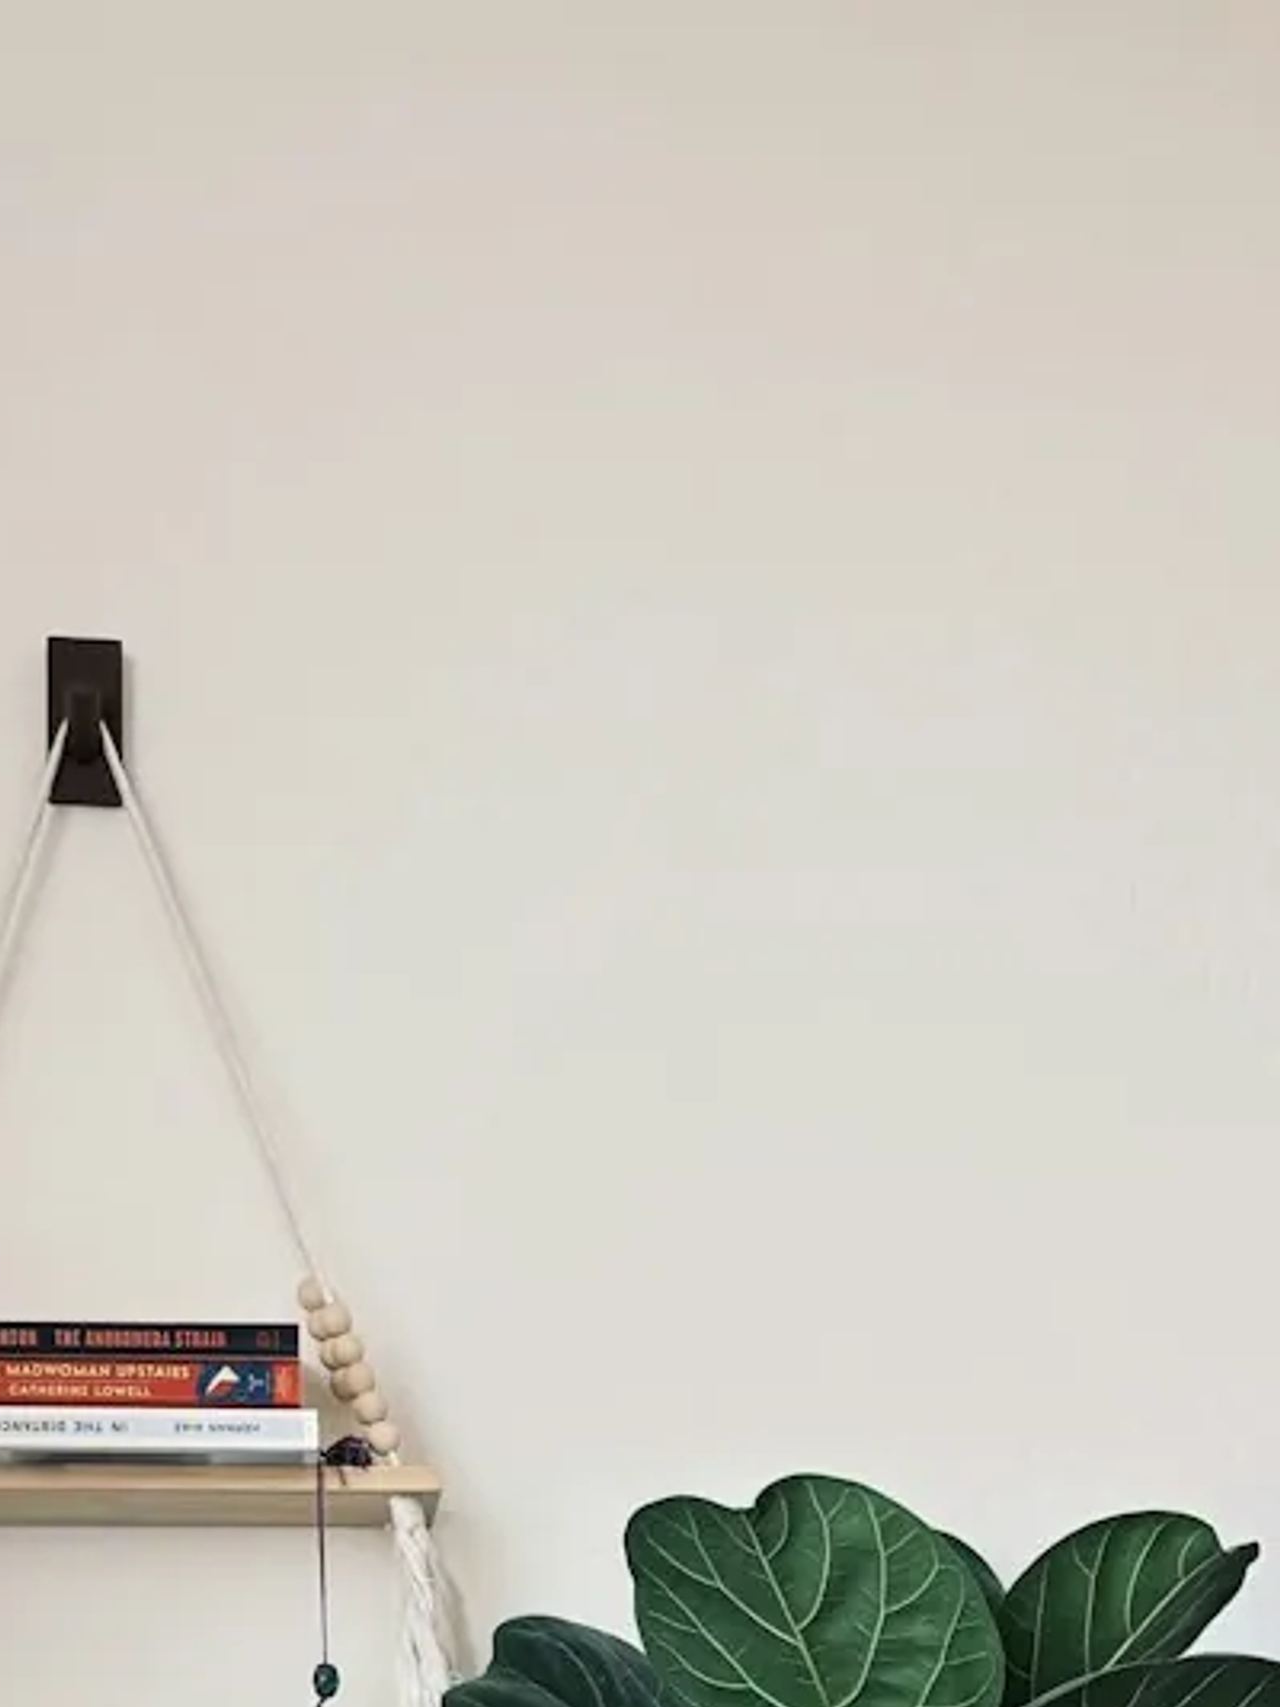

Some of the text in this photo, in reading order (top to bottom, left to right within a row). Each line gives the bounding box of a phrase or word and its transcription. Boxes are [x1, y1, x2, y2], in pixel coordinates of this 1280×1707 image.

[53, 1328, 81, 1346] THE
[5, 1362, 112, 1378] MADWOMAN
[116, 1364, 191, 1379] UPSTAIRS
[8, 1384, 152, 1397] CATHERINE LOWELL
[74, 1420, 103, 1432] THE
